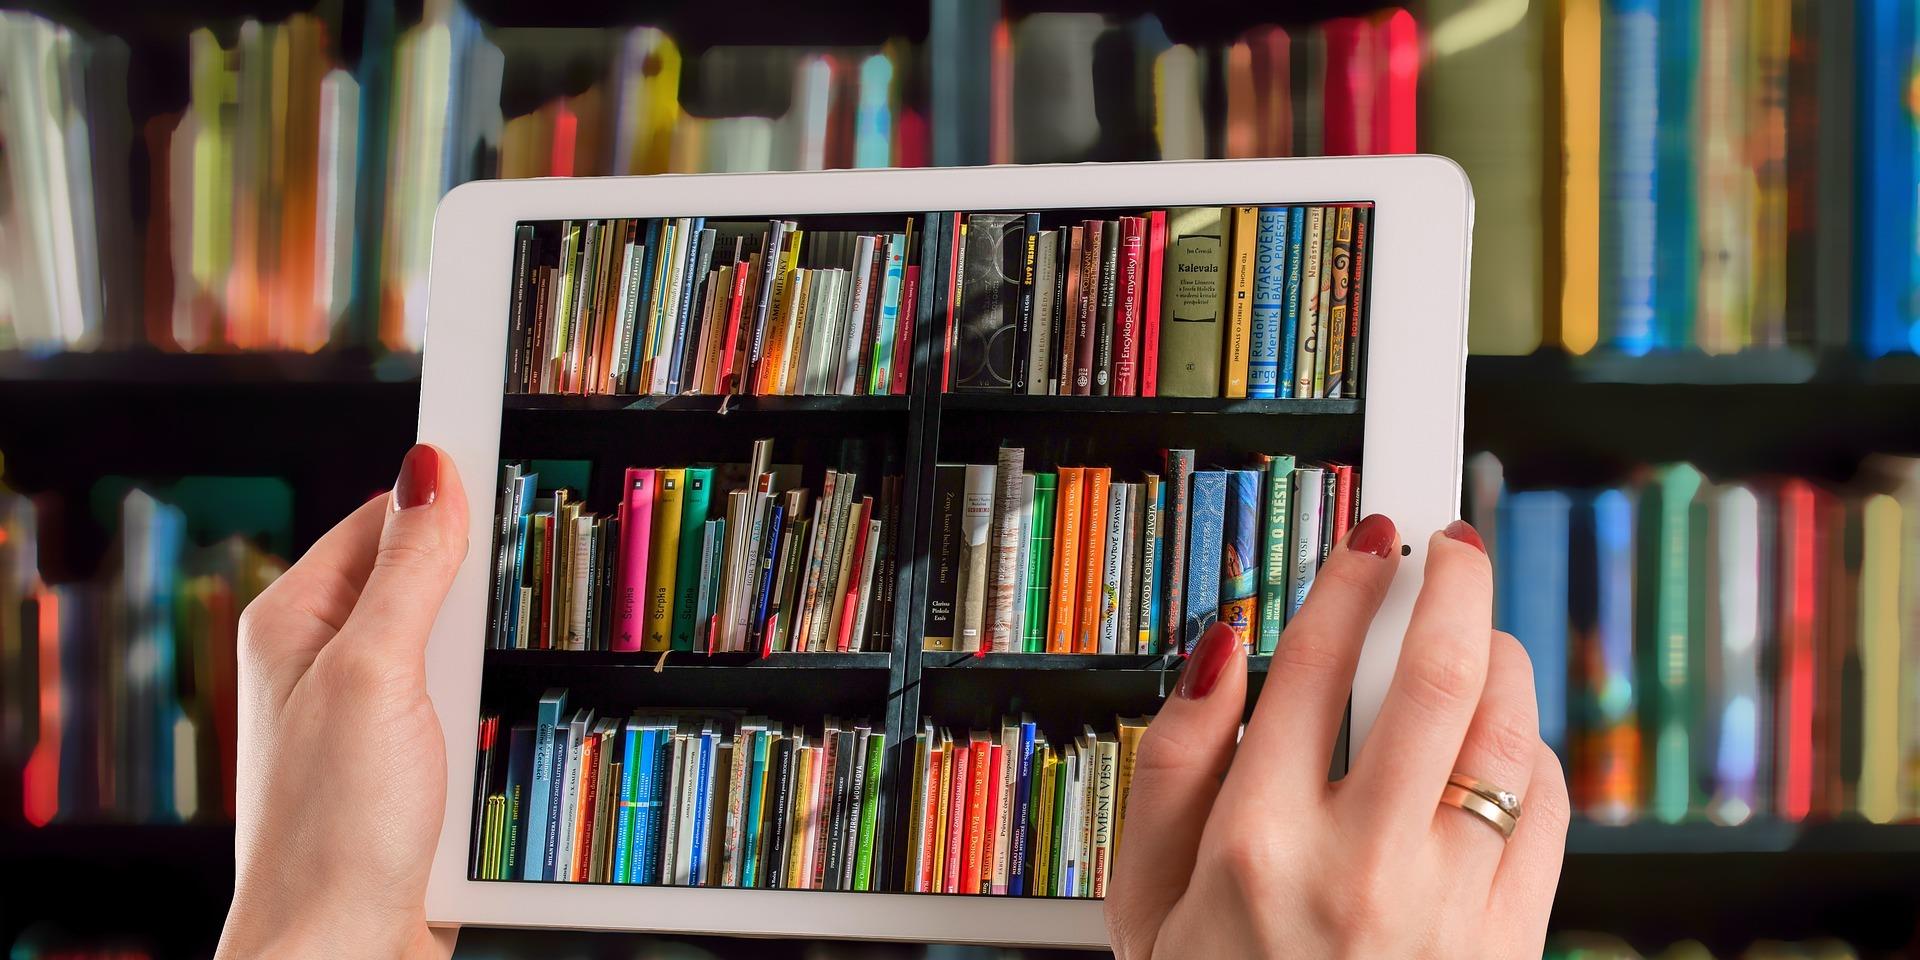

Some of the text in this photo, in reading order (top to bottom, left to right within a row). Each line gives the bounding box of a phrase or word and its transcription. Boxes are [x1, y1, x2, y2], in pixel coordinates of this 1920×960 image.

[775, 258, 787, 295] MILENKY
[1101, 261, 1110, 306] Encyklopedie
[1126, 258, 1136, 294] mystiky
[1178, 264, 1219, 272] Kalevala
[667, 267, 680, 318] Fernando Pessoa
[1272, 276, 1282, 299] BÁJE
[771, 299, 780, 321] SMRT
[1122, 297, 1133, 358] Encyklopedie
[1252, 311, 1264, 357] Rudolf
[1266, 312, 1279, 357] Mertlík
[1251, 370, 1276, 383] argo
[1146, 504, 1156, 536] ŽIVOTA
[1268, 477, 1288, 585] KNIHA O ŠTĚSTÍ
[1144, 537, 1154, 575] OBSLUZE
[1298, 538, 1308, 573] GNOSE
[1140, 585, 1151, 617] NÁVOD
[588, 768, 598, 789] double
[1095, 754, 1112, 844] UMĚNÍ VÉST
[850, 802, 859, 832] VIRGINIA
[549, 821, 557, 847] KUNDERA
[949, 836, 958, 854] CESTA
[1096, 850, 1104, 873] Sharma
